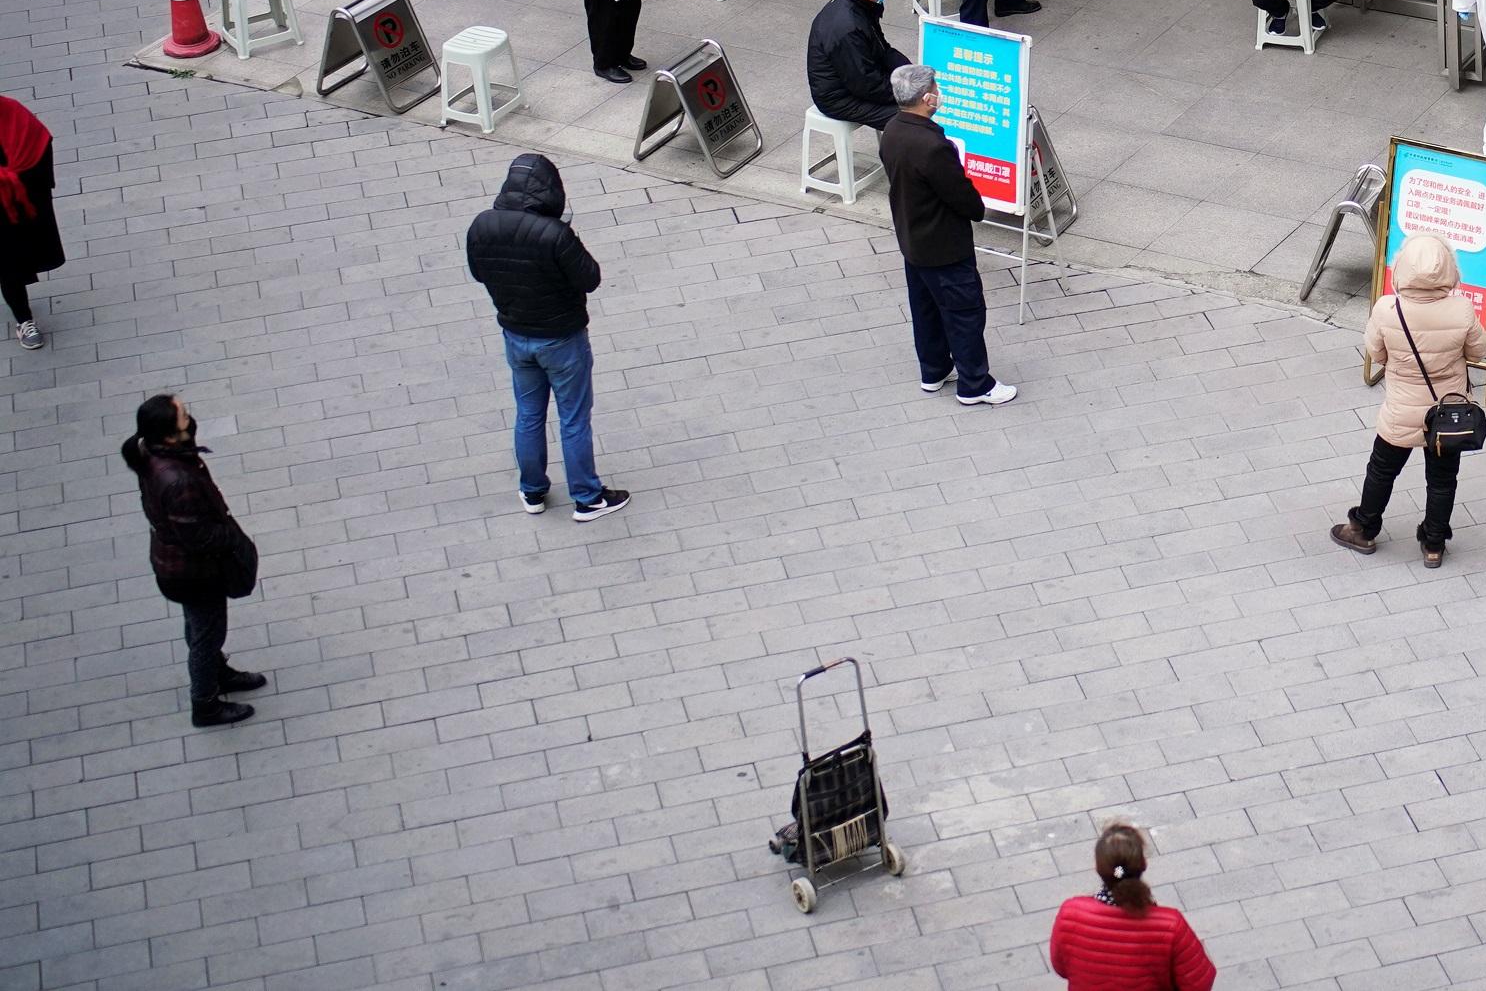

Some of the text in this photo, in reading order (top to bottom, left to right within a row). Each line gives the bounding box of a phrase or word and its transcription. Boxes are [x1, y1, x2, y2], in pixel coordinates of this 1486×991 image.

[380, 40, 421, 70] 请勿泊车
[966, 158, 1011, 178] 请佩戴口罩
